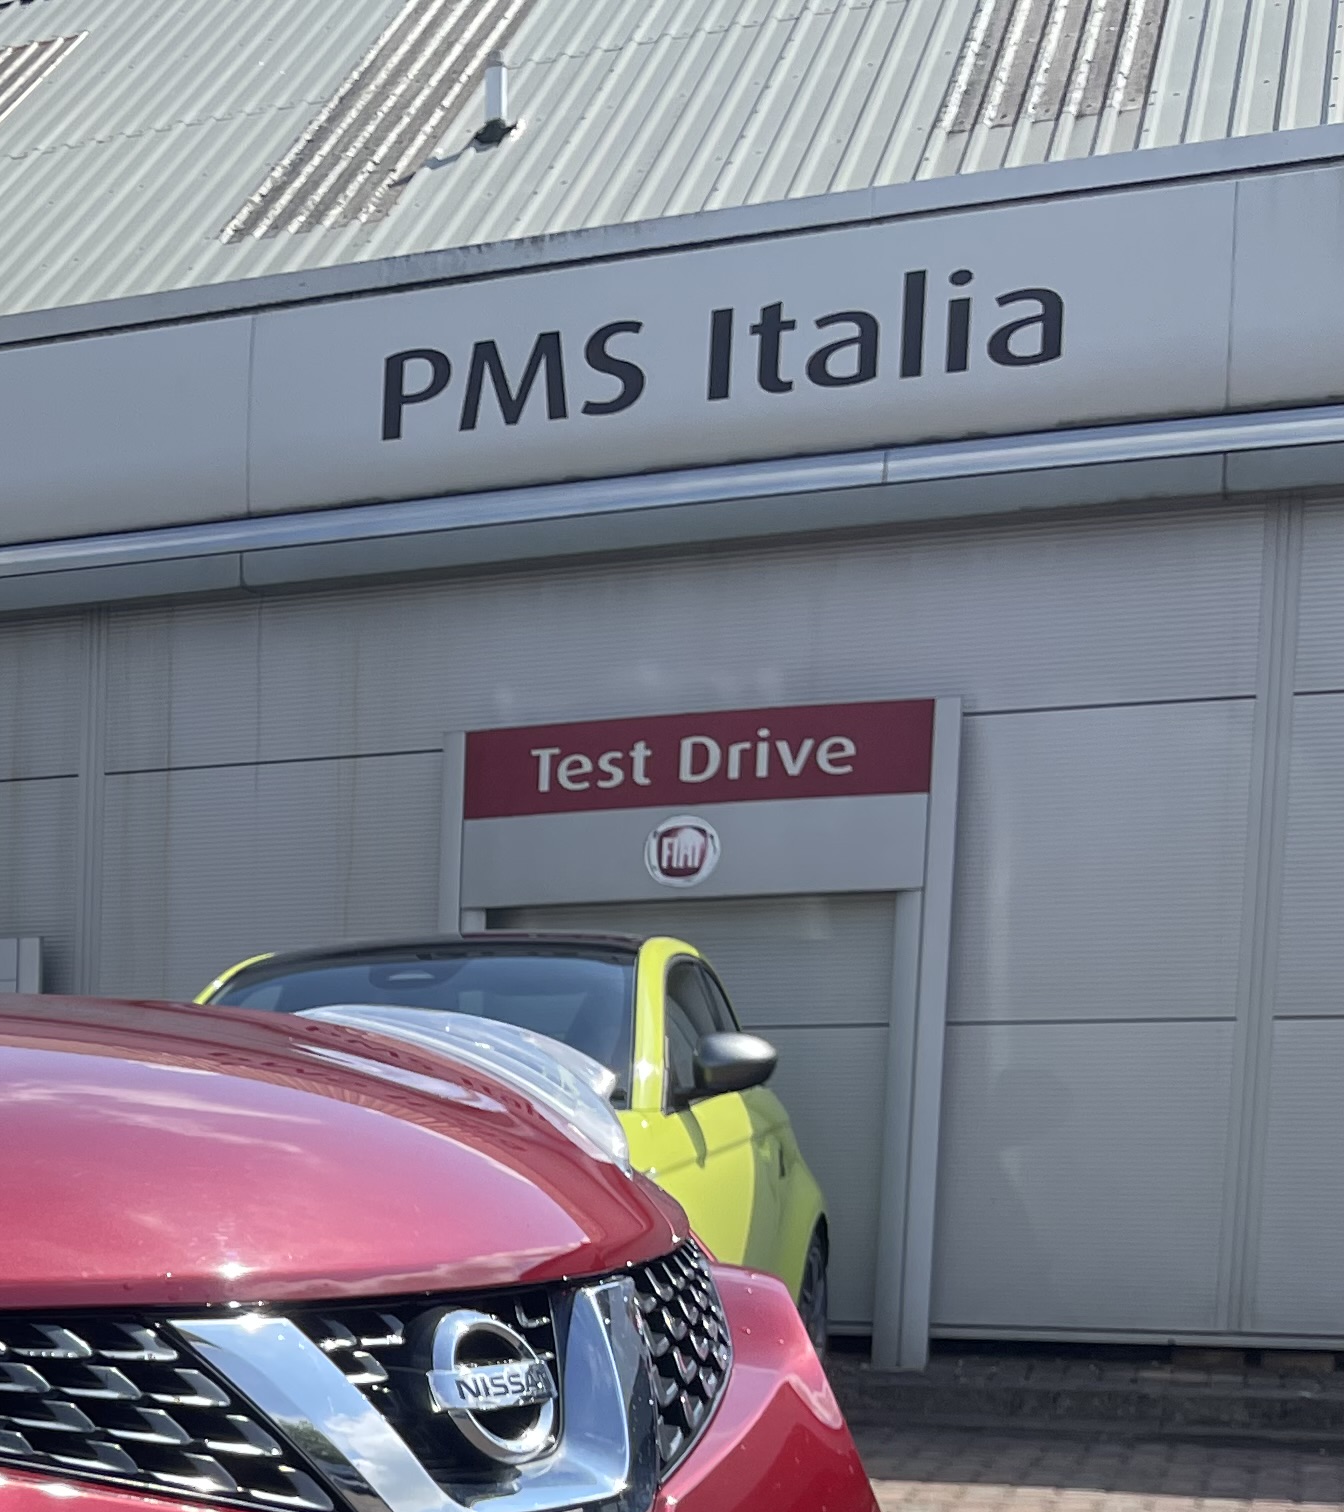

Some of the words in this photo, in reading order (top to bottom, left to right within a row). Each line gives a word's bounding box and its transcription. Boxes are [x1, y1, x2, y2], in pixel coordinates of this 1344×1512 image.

[381, 319, 646, 441] PMS
[706, 268, 1065, 401] Italia
[530, 740, 653, 793] Test
[678, 728, 858, 784] Drive
[454, 1368, 553, 1401] NISSAN
